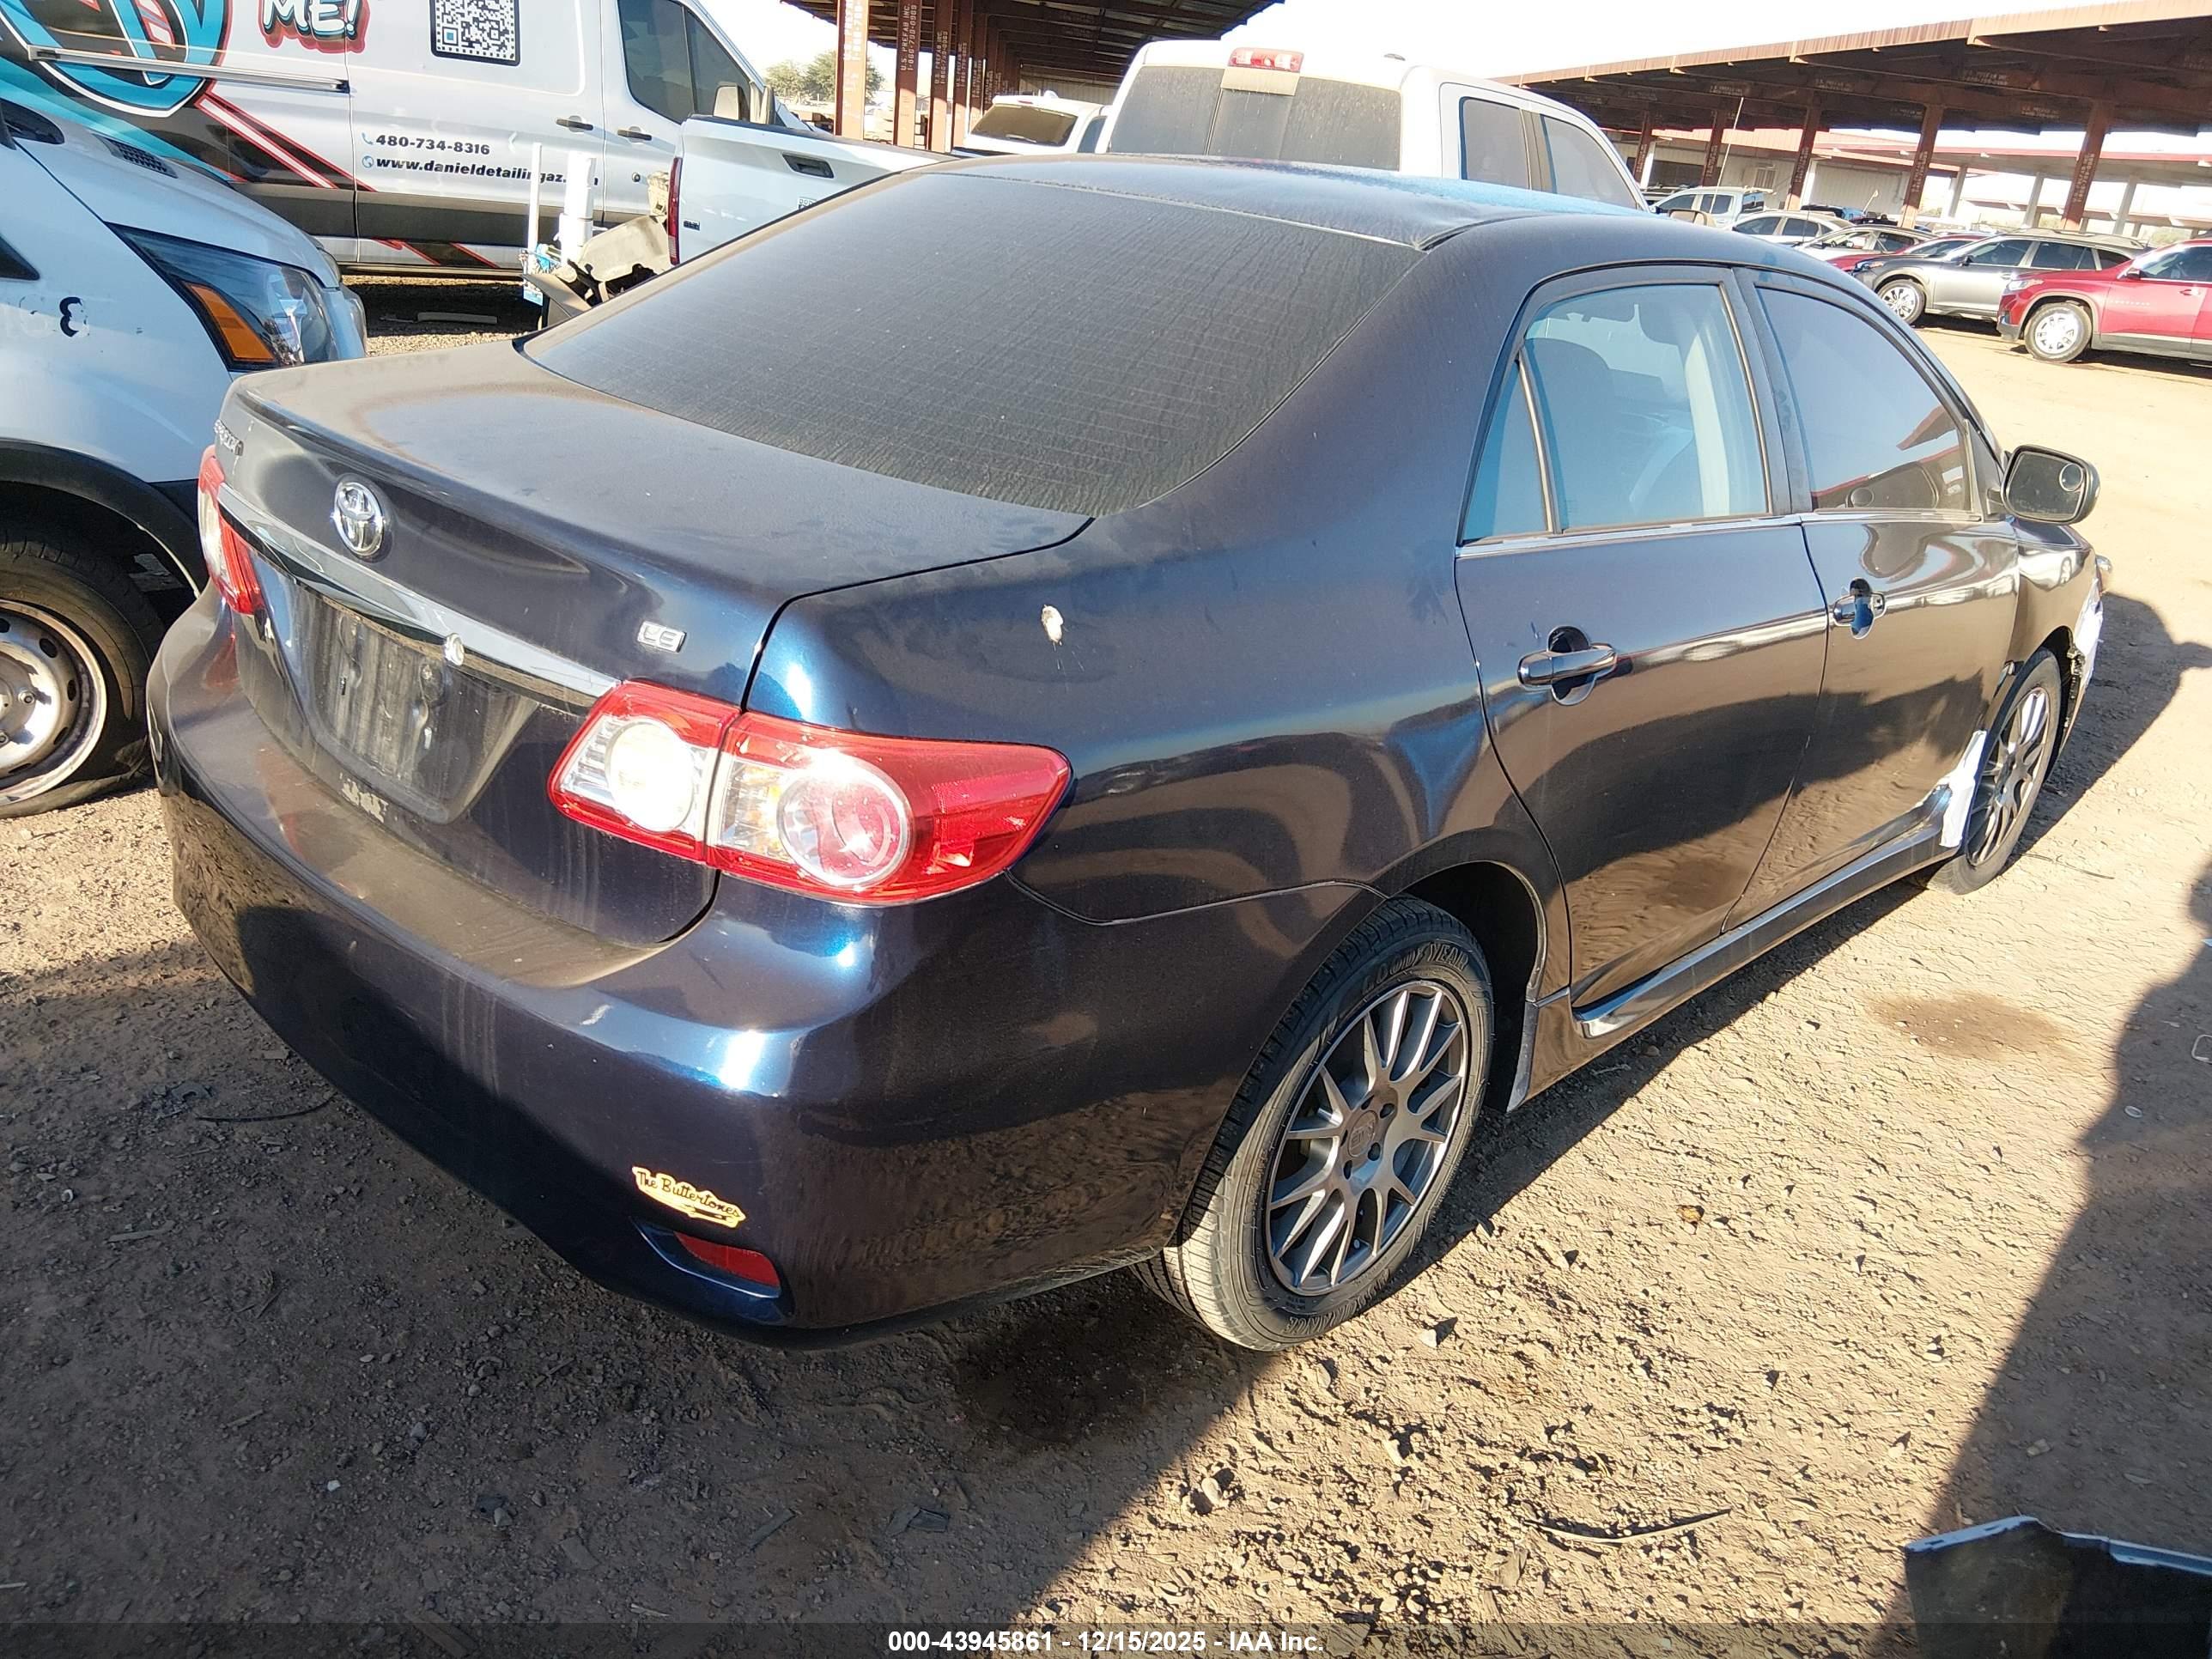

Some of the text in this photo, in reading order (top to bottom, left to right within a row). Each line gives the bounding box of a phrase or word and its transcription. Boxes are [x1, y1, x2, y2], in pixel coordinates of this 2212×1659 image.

[263, 0, 358, 40] ME!
[902, 21, 910, 52] PREFAB
[376, 135, 490, 155] 480-734-8316
[637, 1170, 741, 1218] The Buttertones
